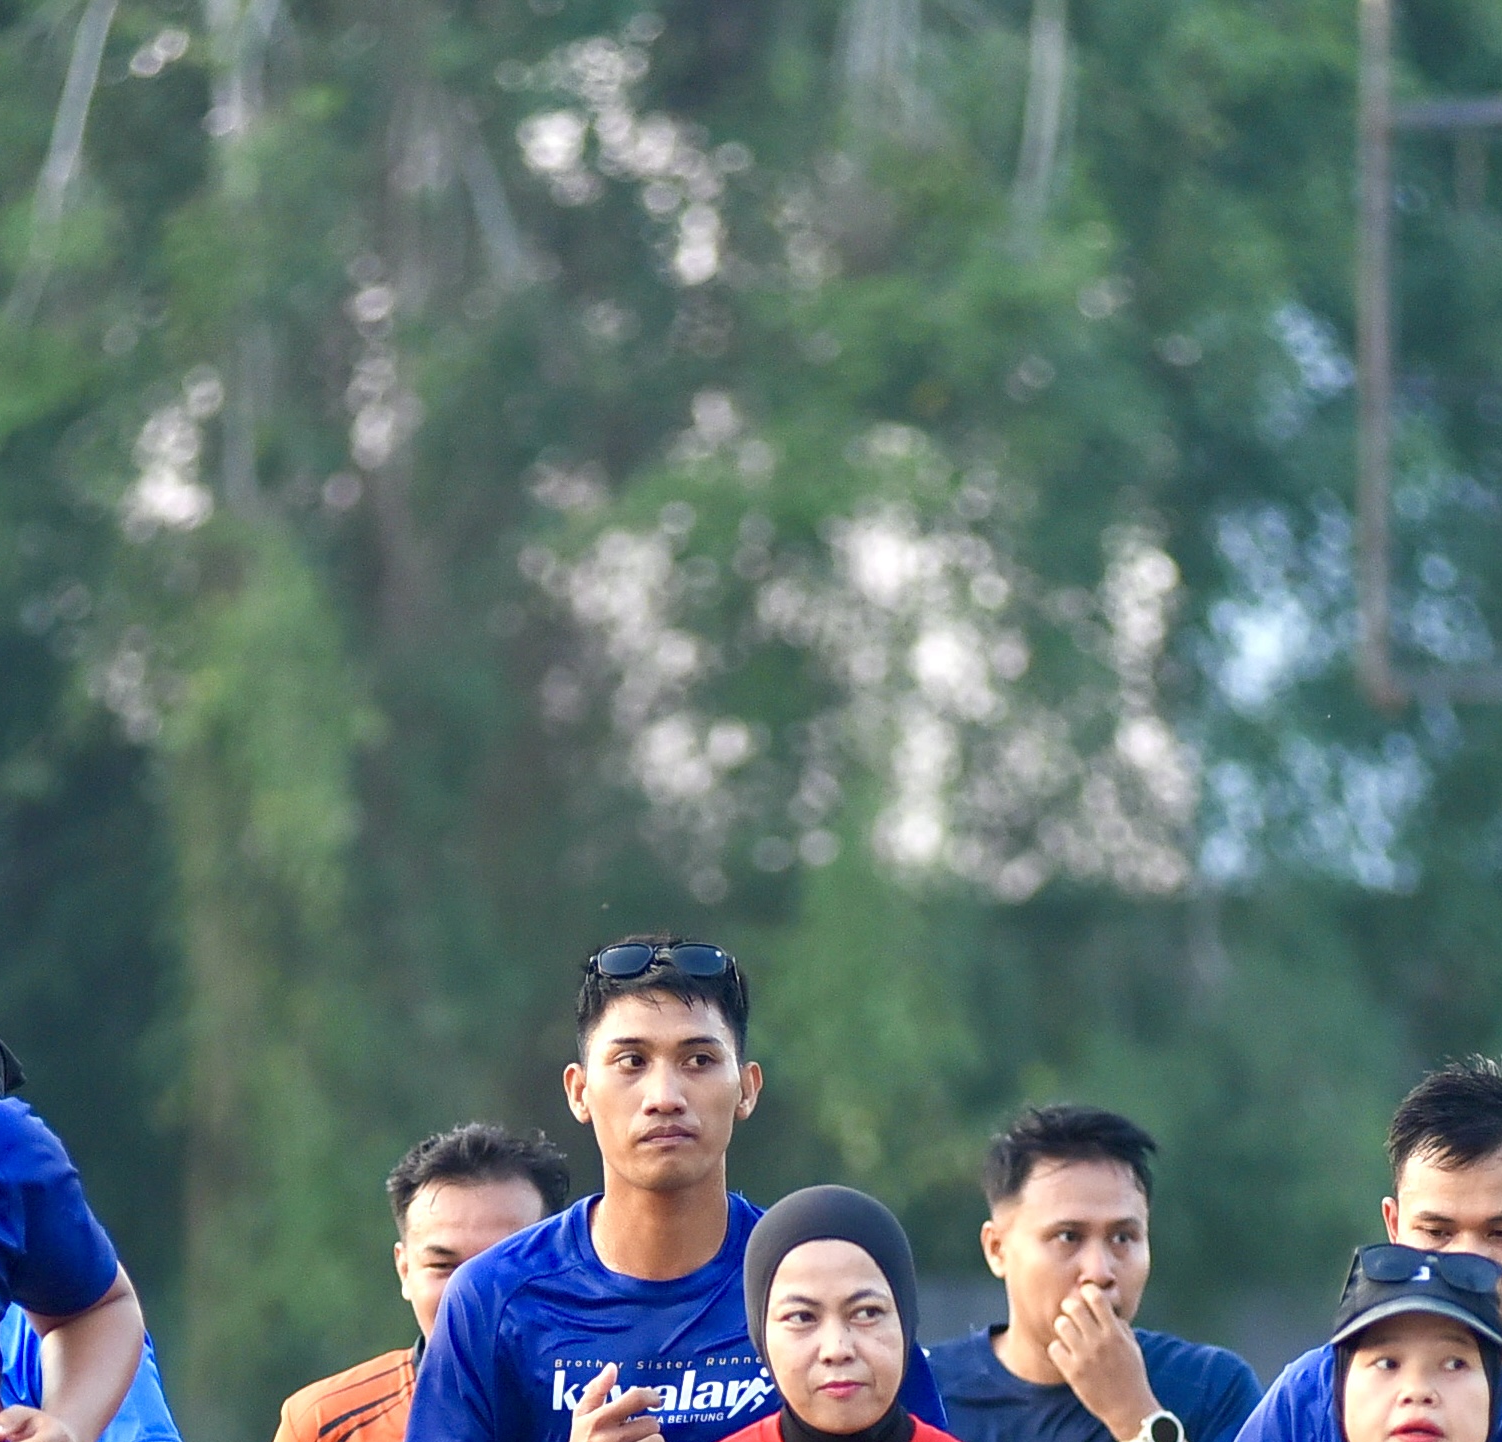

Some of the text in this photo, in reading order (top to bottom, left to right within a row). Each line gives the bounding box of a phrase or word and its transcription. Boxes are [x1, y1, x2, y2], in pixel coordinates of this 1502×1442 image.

[554, 1358, 624, 1369] Brothr
[636, 1359, 694, 1370] Sister
[667, 1411, 724, 1424] BELITUNG
